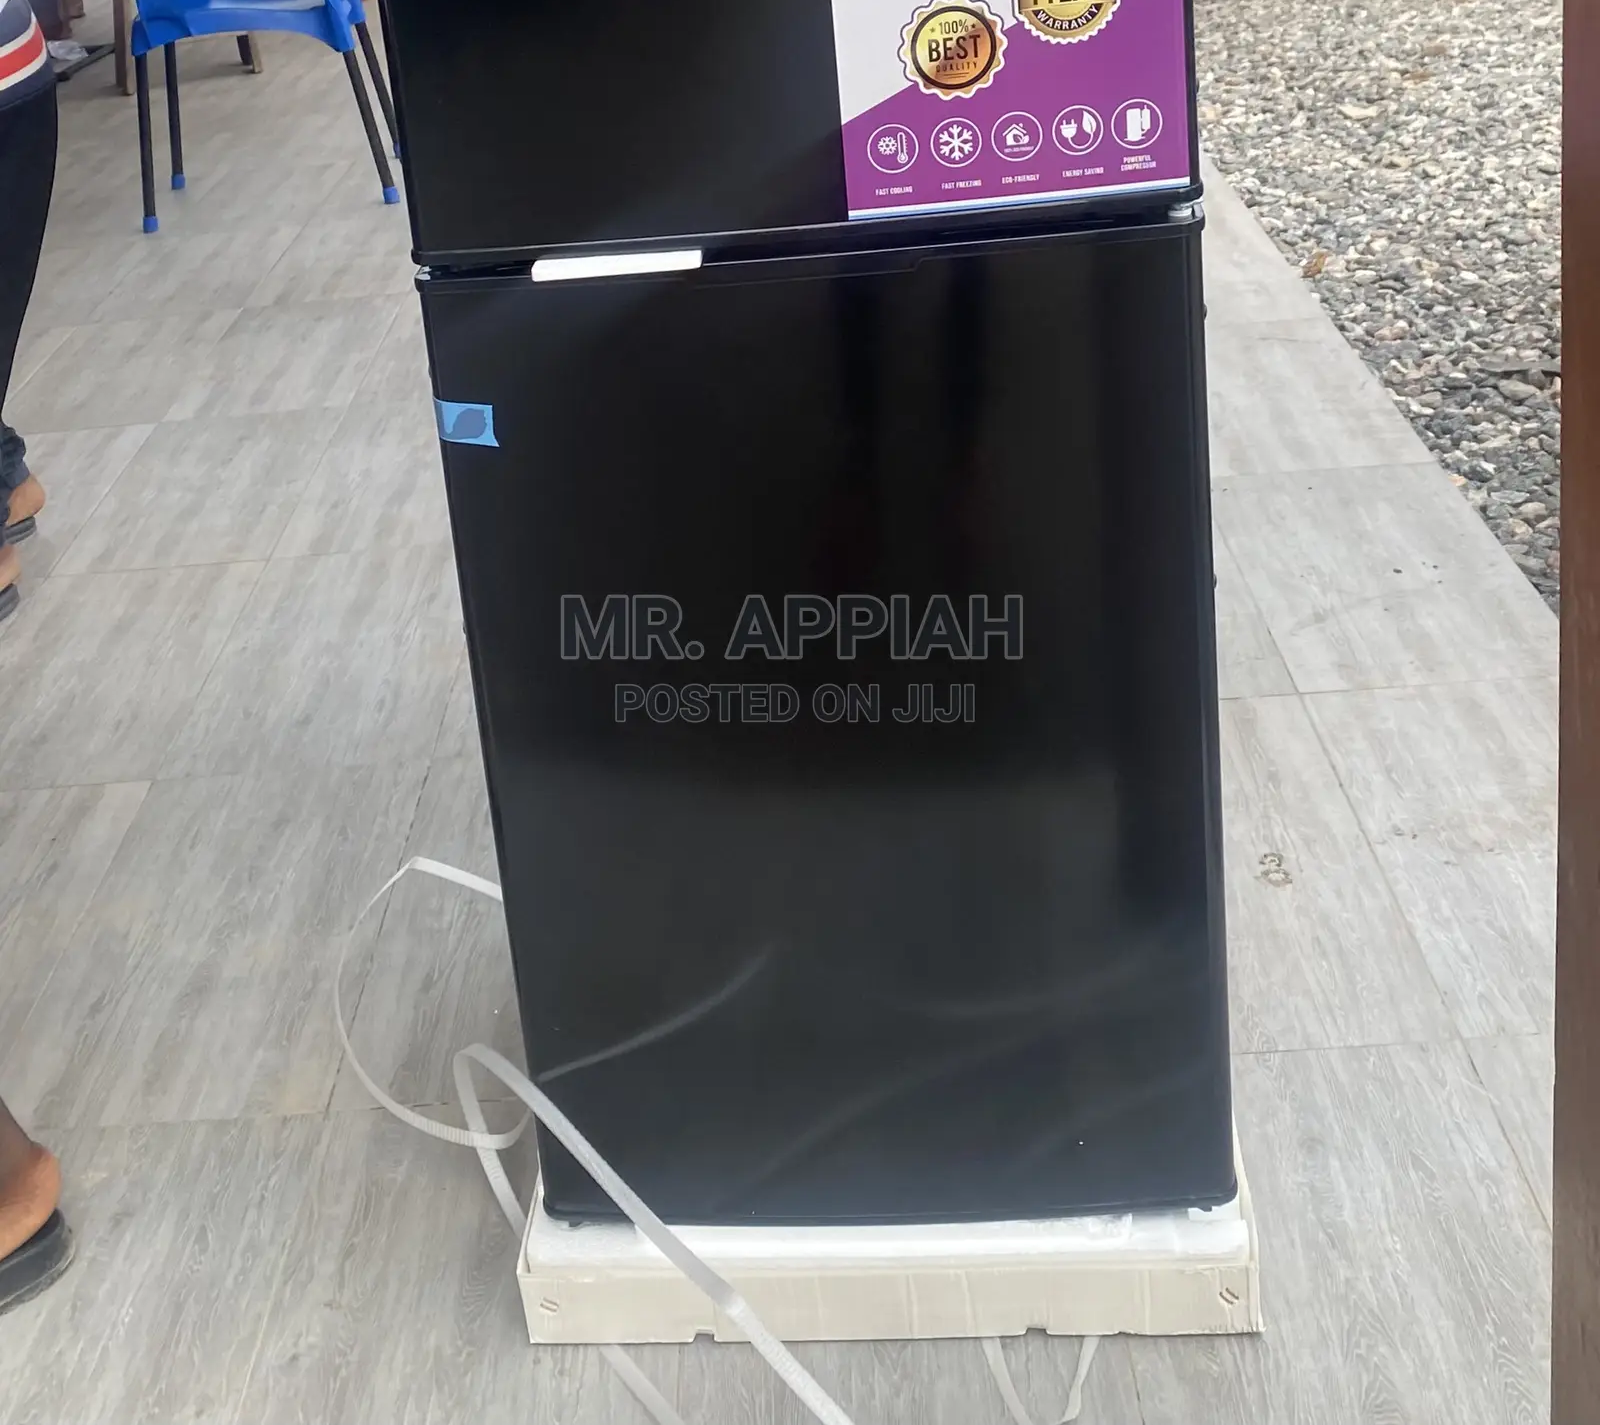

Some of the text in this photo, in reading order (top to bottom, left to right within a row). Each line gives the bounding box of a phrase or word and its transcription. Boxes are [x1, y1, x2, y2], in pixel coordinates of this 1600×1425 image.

[1035, 4, 1099, 31] WARRANTY
[938, 18, 969, 36] 100%
[927, 34, 982, 63] BEST
[935, 61, 979, 74] QUALITY
[1062, 166, 1104, 178] ENERGY SAVING
[941, 179, 982, 190] FAST FREEZING
[1001, 173, 1040, 184] ECO-FRIENDLY
[875, 185, 913, 196] FAST COOLING
